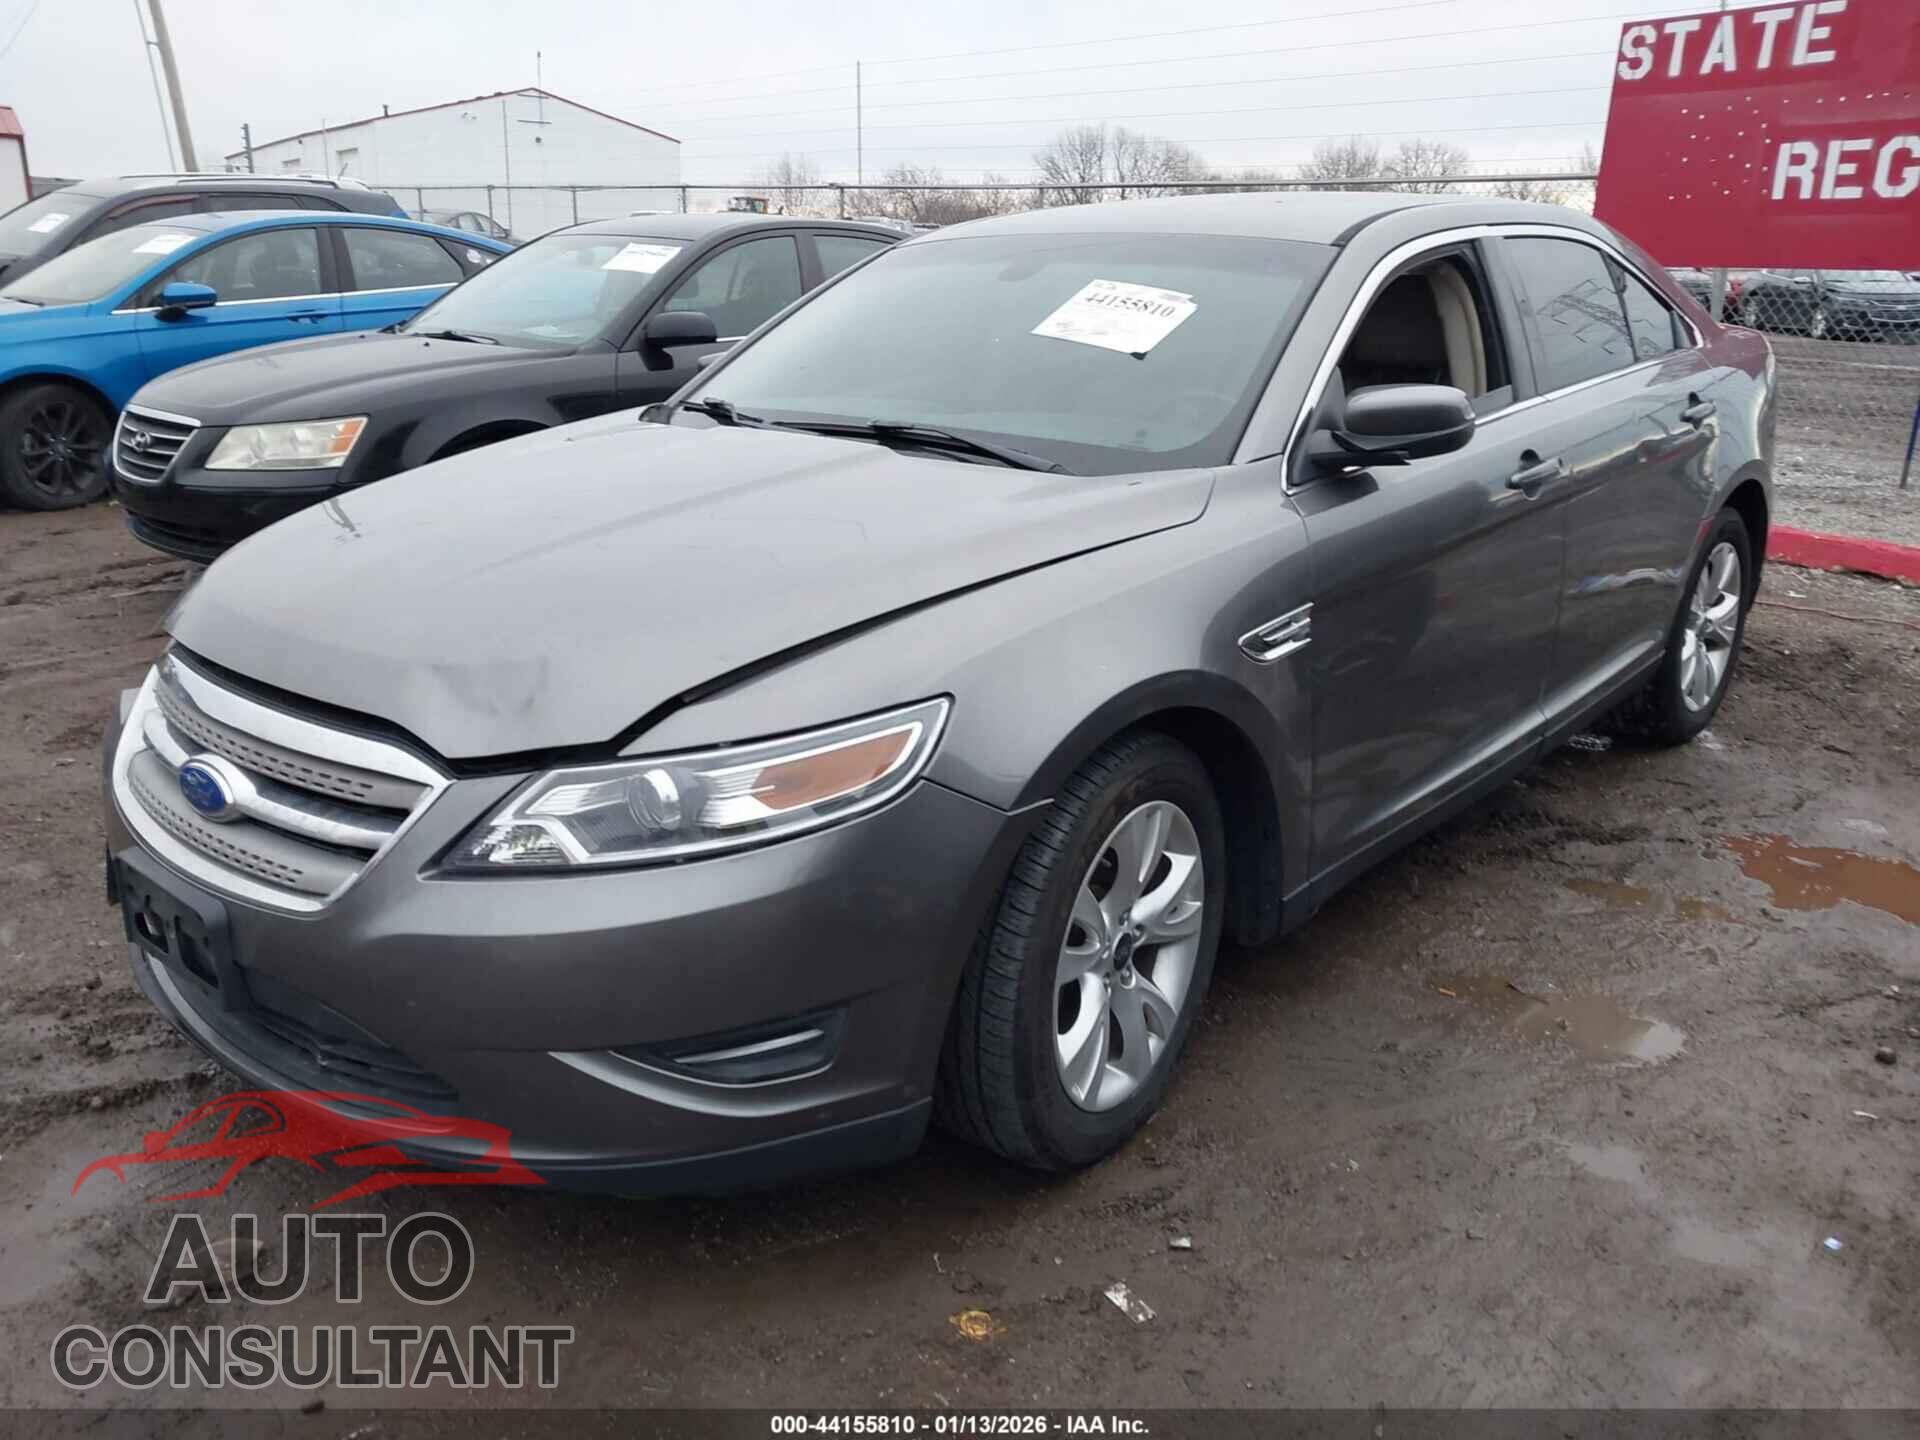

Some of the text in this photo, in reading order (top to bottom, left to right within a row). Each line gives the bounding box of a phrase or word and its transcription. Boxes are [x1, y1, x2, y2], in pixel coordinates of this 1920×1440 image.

[1616, 0, 1848, 80] STATE
[1771, 135, 1920, 200] REG
[1086, 293, 1176, 318] 44155810
